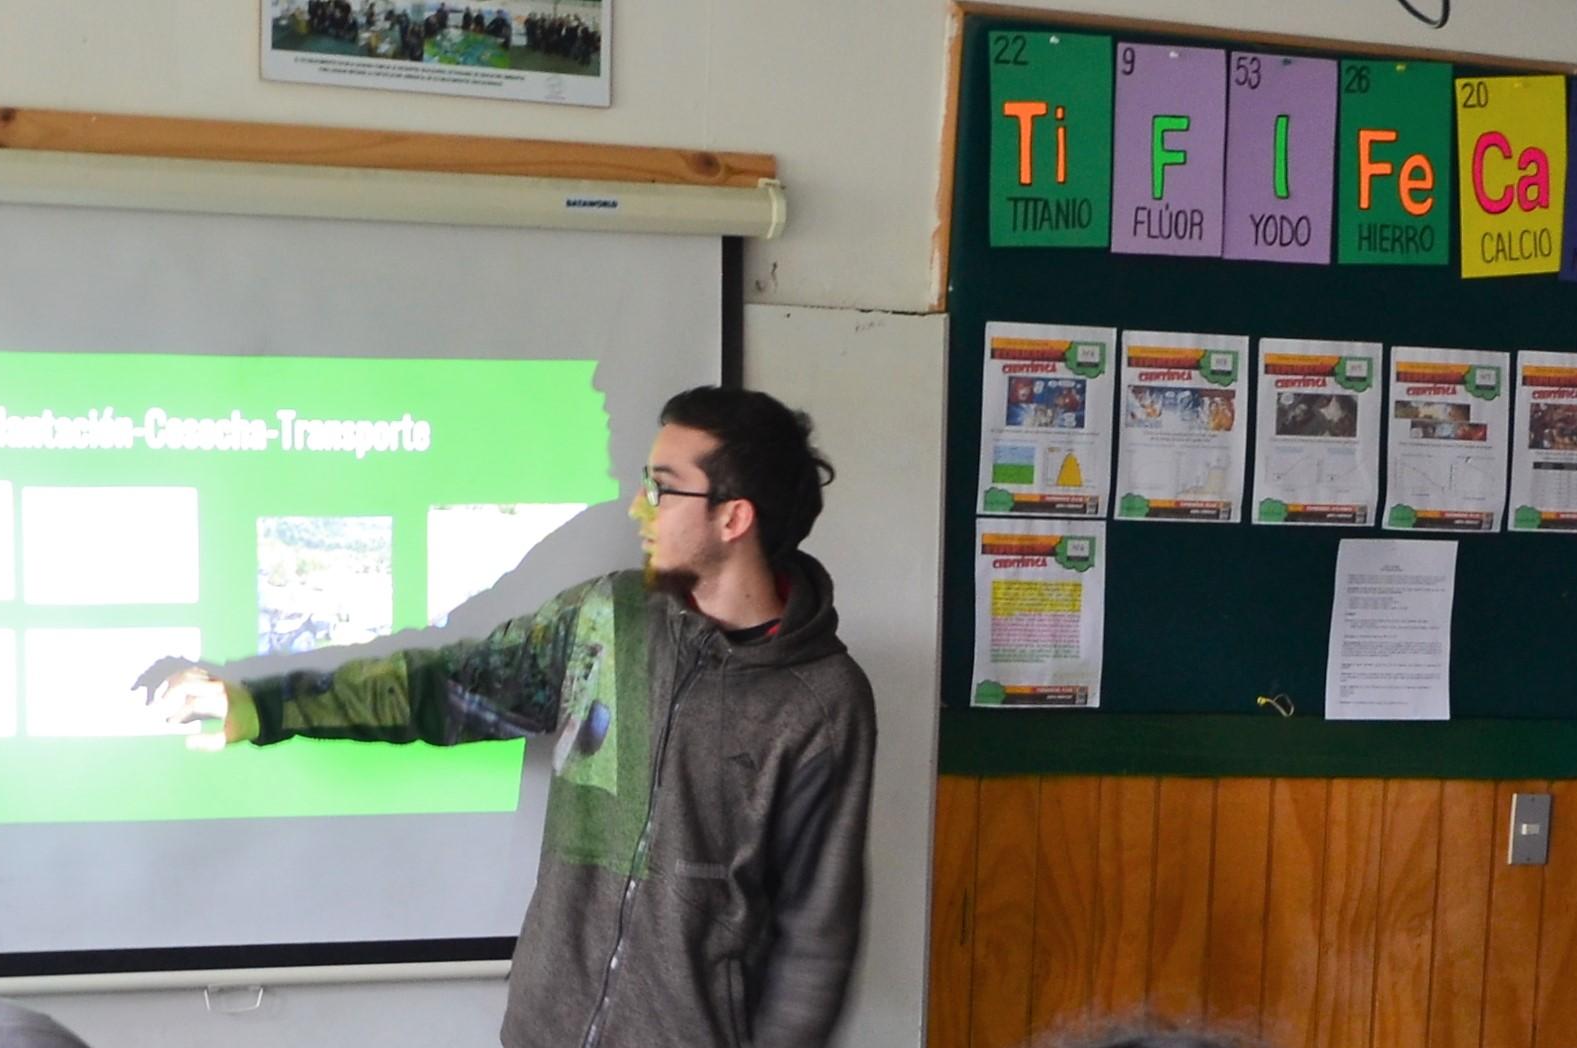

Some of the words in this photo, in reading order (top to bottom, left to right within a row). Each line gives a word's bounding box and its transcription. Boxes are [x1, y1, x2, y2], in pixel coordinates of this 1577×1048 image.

[993, 35, 1029, 66] 22
[1122, 48, 1135, 76] 9
[1235, 57, 1262, 89] 53
[1344, 65, 1371, 94] 26
[1461, 80, 1488, 108] 20
[1002, 101, 1068, 186] Ti
[1151, 115, 1191, 200] F
[1272, 114, 1290, 199] I
[1357, 128, 1434, 217] Fe
[1470, 130, 1551, 215] Ca
[1009, 198, 1092, 231] TITANIO
[1133, 204, 1204, 240] FLÚOR
[1249, 214, 1311, 247] YODO
[1357, 224, 1434, 253] HIERRO
[1481, 227, 1552, 264] CALCIO
